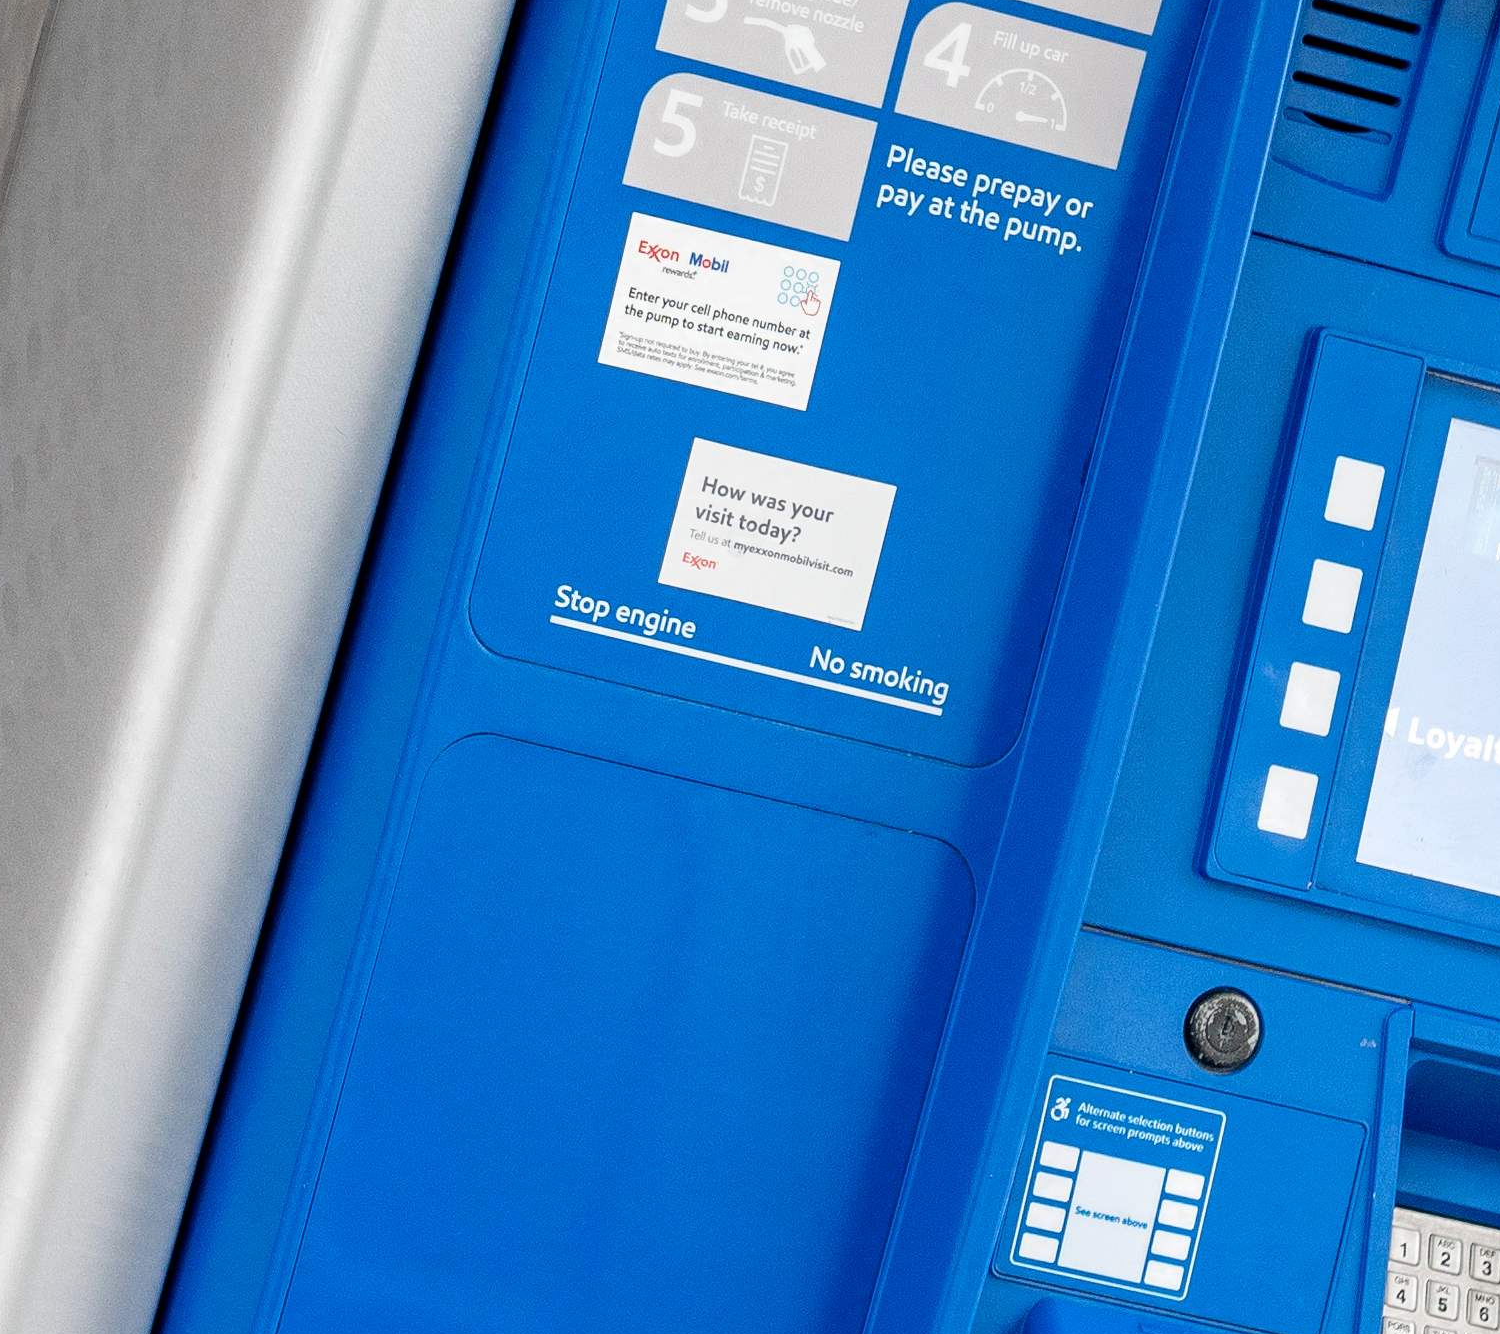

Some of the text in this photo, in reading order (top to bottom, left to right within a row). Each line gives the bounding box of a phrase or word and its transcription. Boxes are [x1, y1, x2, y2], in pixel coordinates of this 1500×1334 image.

[813, 9, 866, 32] nozzle
[924, 23, 972, 87] 4
[652, 90, 704, 157] 5
[886, 144, 1093, 218] Please prepay or
[876, 184, 1081, 254] pay at the pump.
[638, 240, 729, 273] Exxon Mobil
[624, 304, 643, 318] the
[645, 311, 679, 328] pump
[682, 318, 694, 329] to
[696, 323, 723, 336] start
[726, 330, 769, 350] earning
[628, 286, 810, 339] Enter your cell phone number at
[701, 476, 834, 522] How was your
[695, 504, 801, 544] visit today?
[682, 551, 716, 570] Exxon
[733, 542, 853, 577] myexxonmobilvisit.com
[554, 585, 695, 638] Stop engine
[809, 646, 948, 705] No smoking
